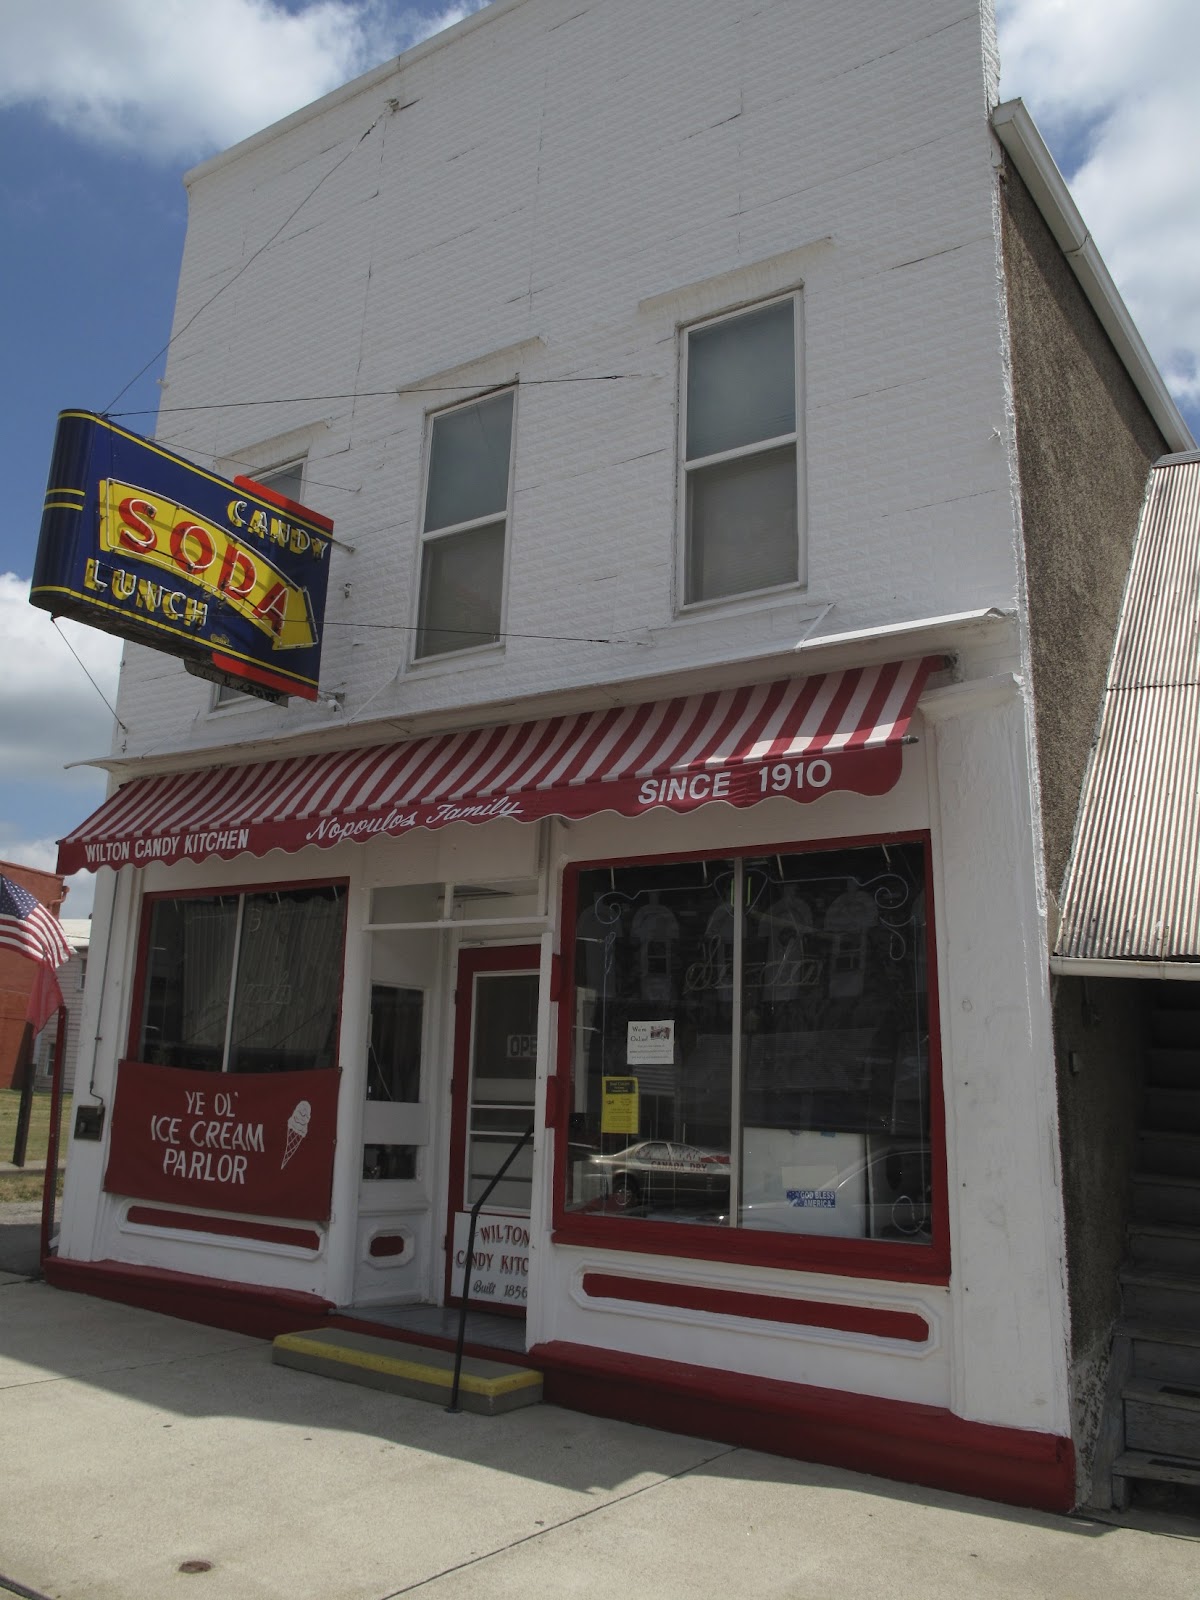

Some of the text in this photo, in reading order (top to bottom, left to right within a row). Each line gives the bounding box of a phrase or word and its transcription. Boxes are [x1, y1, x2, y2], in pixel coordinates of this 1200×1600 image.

[226, 500, 329, 559] CANDY
[118, 497, 289, 637] SODA
[84, 557, 208, 628] LUNCH
[637, 759, 832, 805] SINCE 1910
[306, 795, 525, 842] Nopoulos Family
[85, 828, 250, 863] WILTON CANDY KITCHEN
[185, 1090, 239, 1118] YE OL'
[151, 1114, 265, 1153] ICE CREAM
[162, 1148, 248, 1185] PARLOR
[651, 1160, 708, 1173] CANADA DRY
[800, 1191, 835, 1200] GOD BLESS
[456, 1250, 494, 1270] CNDY
[473, 1280, 528, 1299] Built 1856
